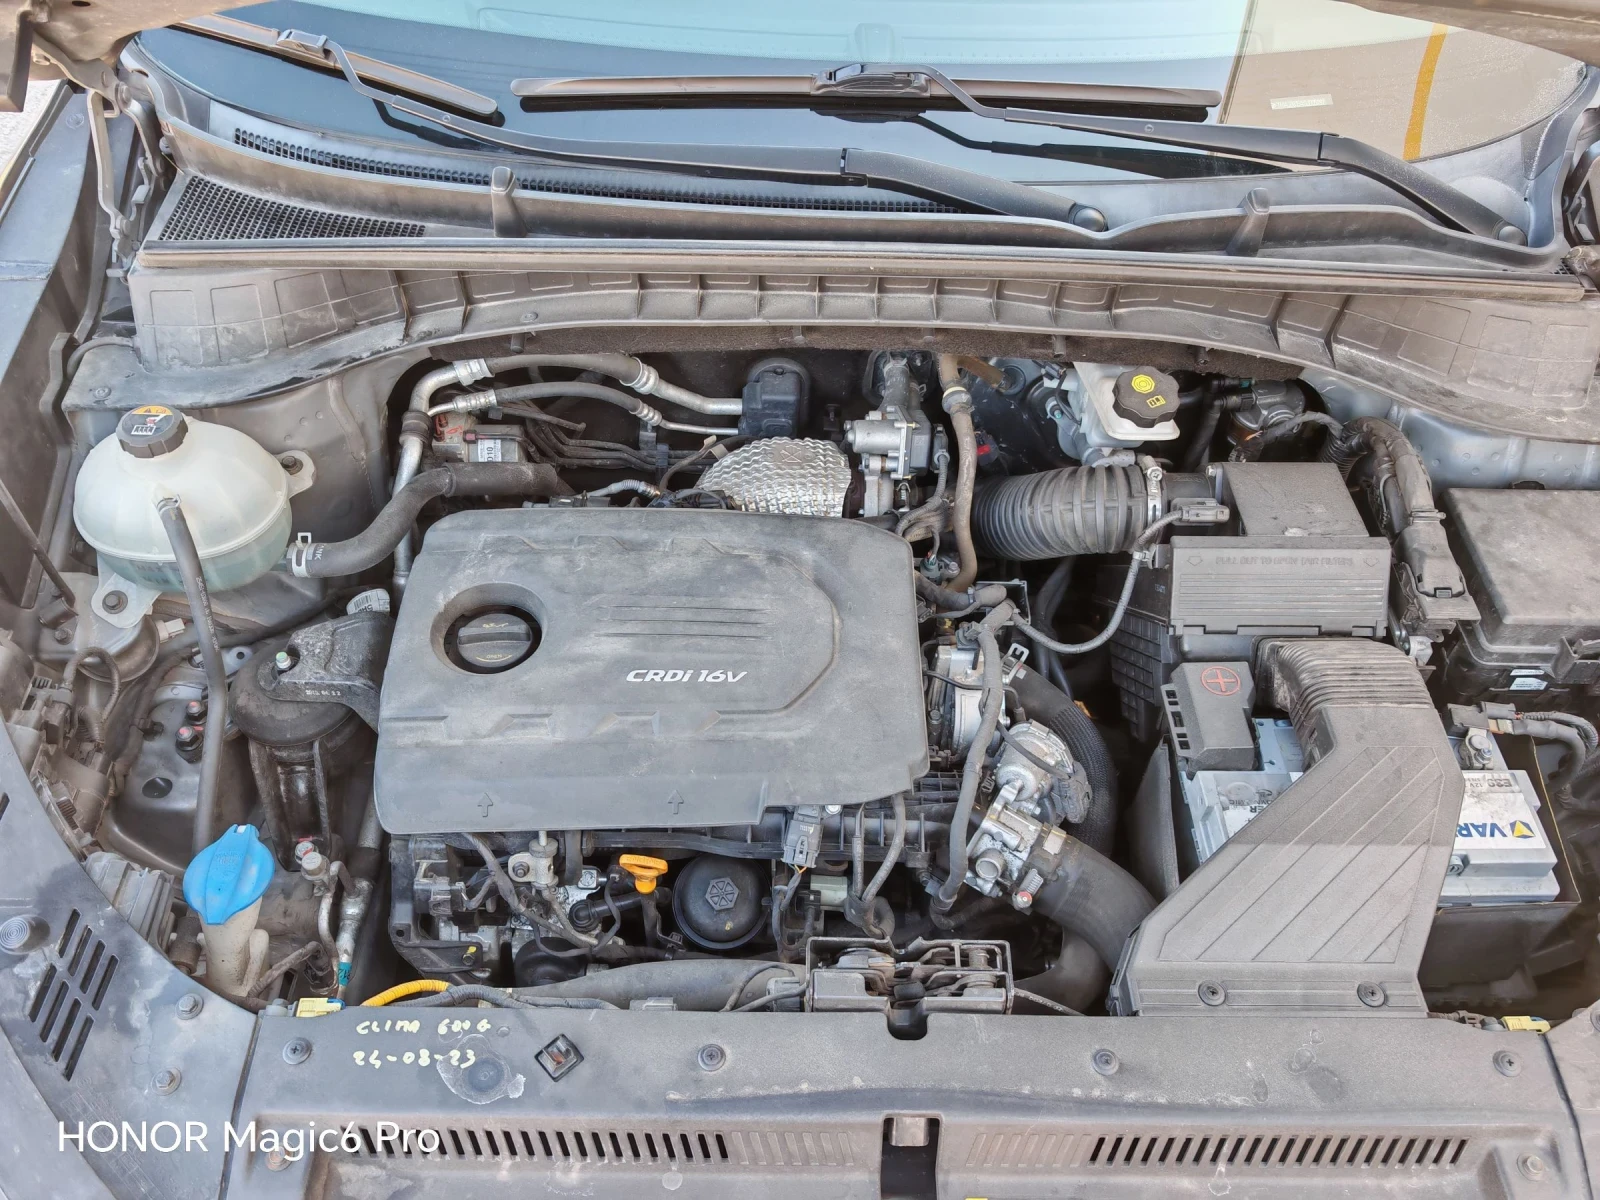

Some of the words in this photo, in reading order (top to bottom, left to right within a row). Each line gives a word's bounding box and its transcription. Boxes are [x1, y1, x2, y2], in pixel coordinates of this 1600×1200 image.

[626, 669, 694, 682] CRDi
[697, 669, 748, 683] 16V
[1454, 822, 1508, 838] VAR
[356, 1019, 421, 1035] CLIMA
